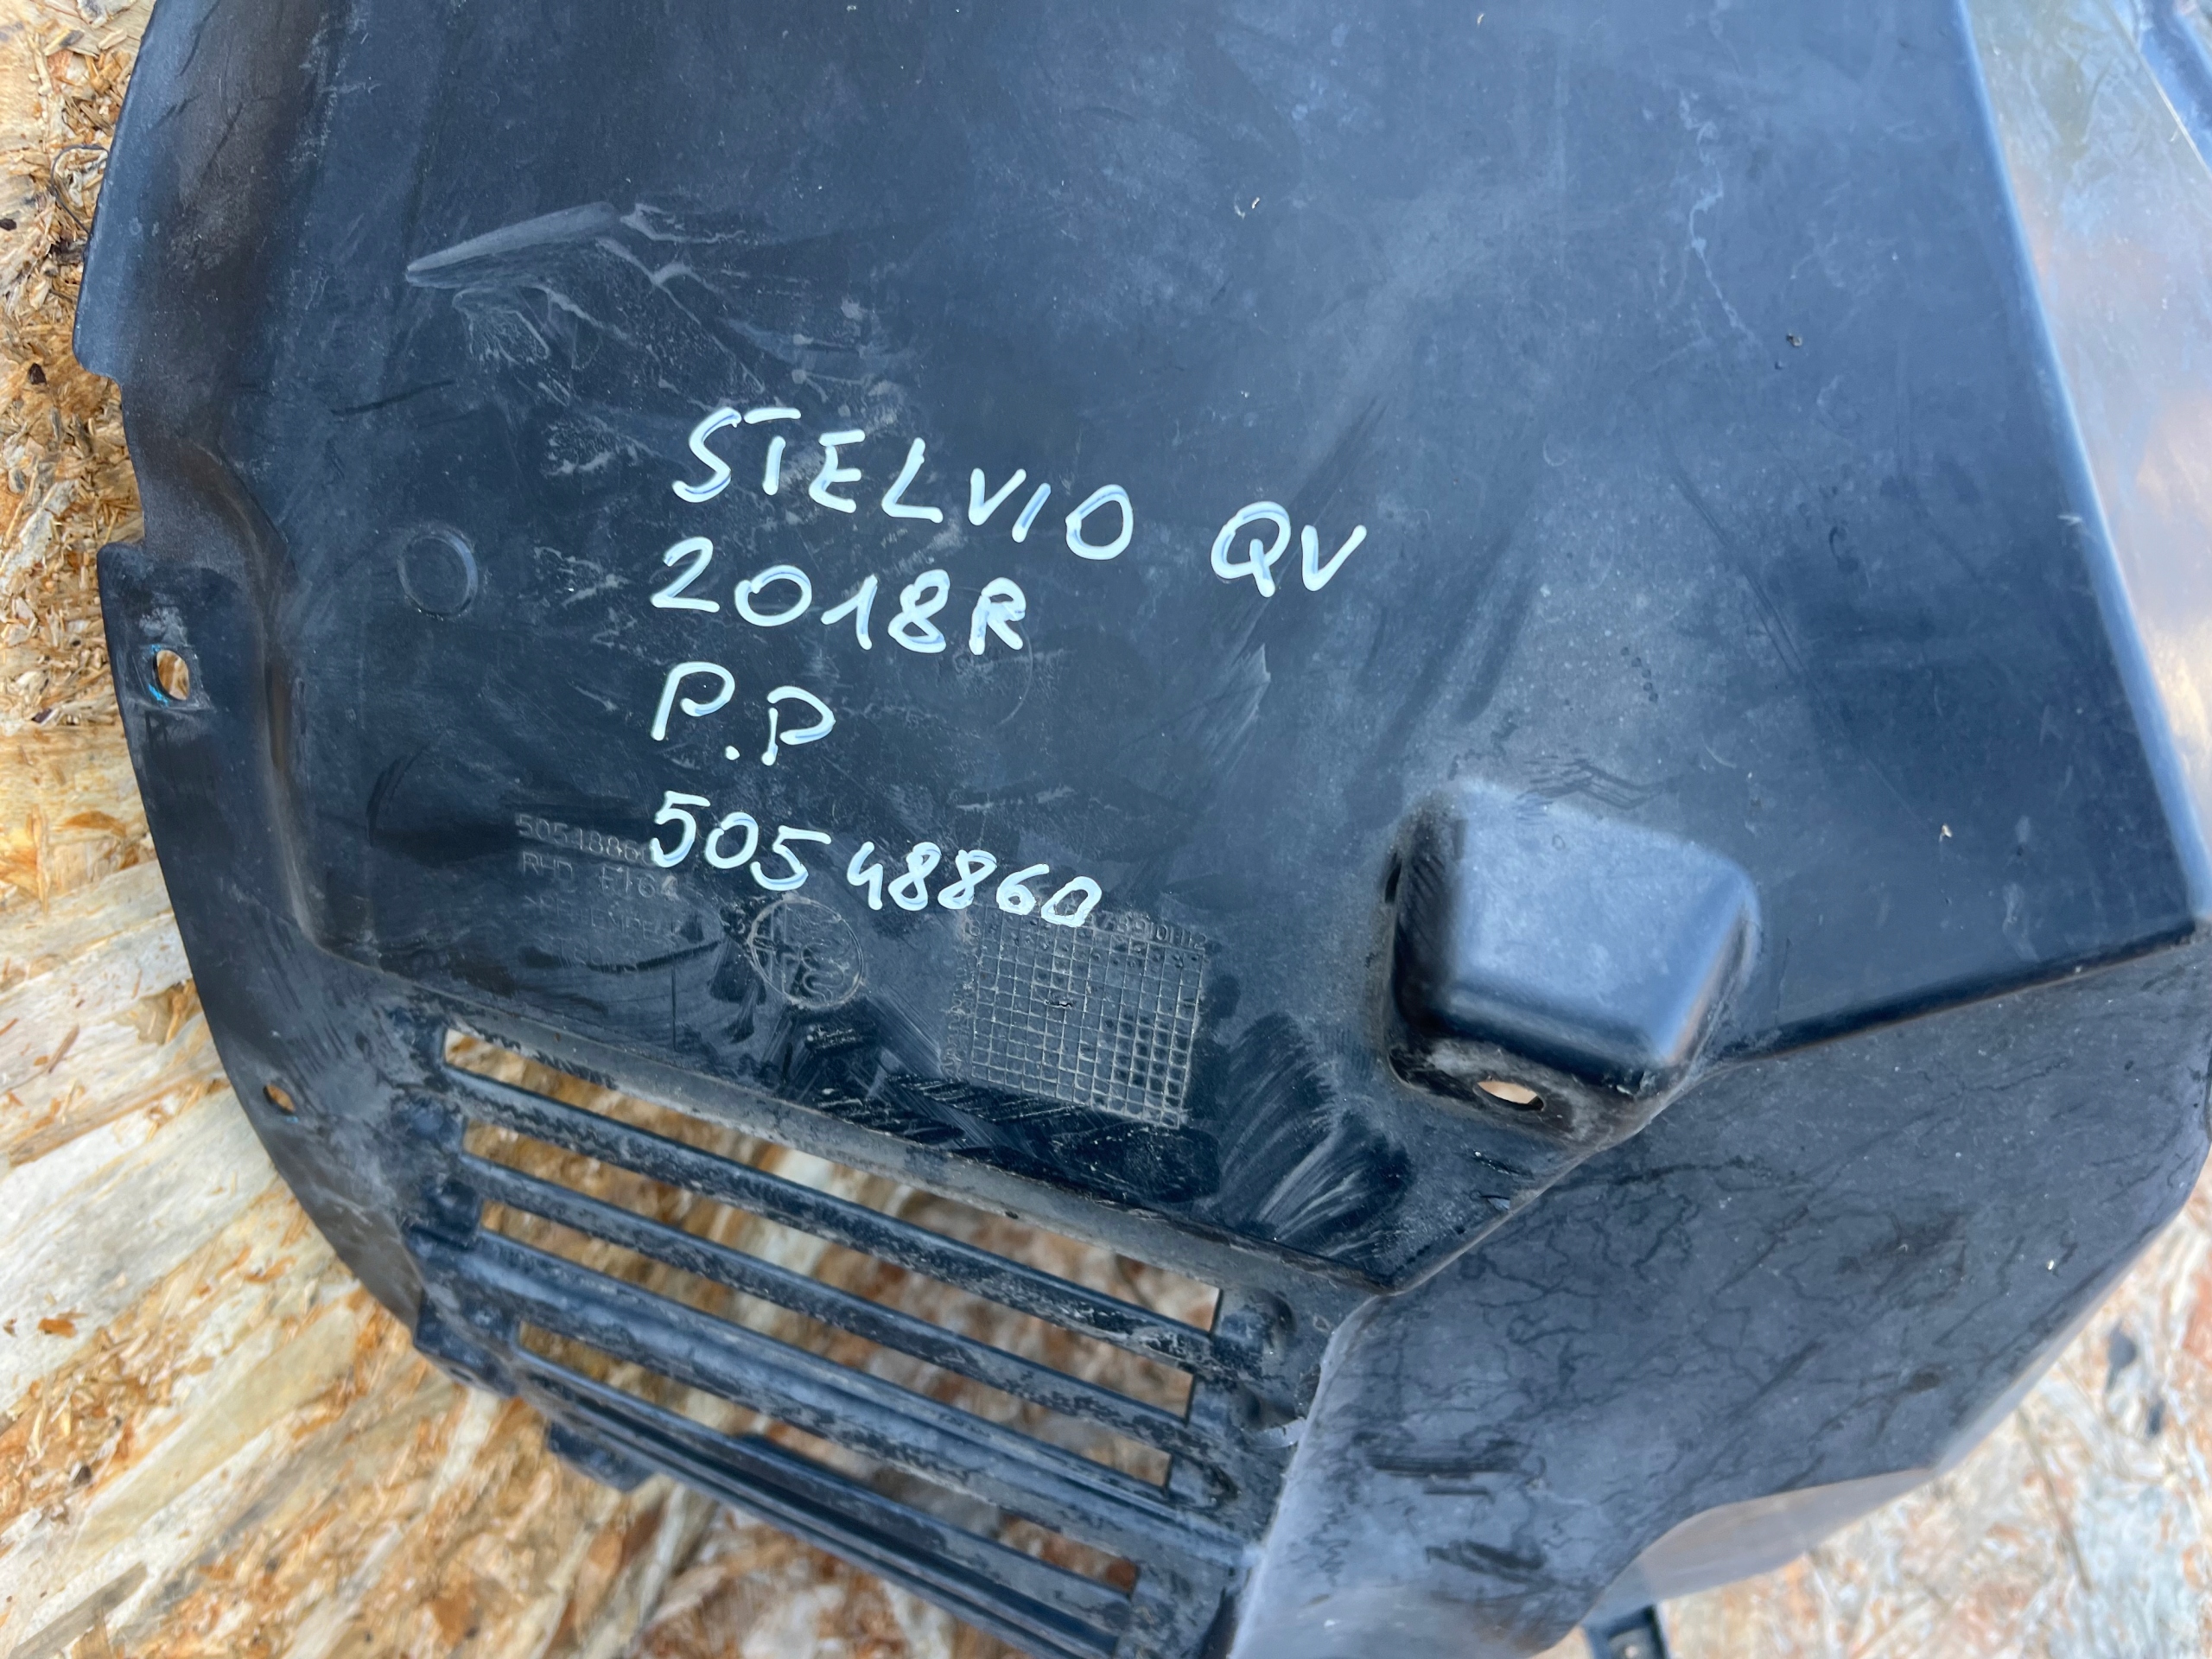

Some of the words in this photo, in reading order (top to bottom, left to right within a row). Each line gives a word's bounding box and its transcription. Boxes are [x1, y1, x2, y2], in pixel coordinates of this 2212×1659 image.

[671, 406, 1134, 561] STELVIO
[1210, 500, 1368, 598] QV
[650, 536, 1027, 656] 2018R
